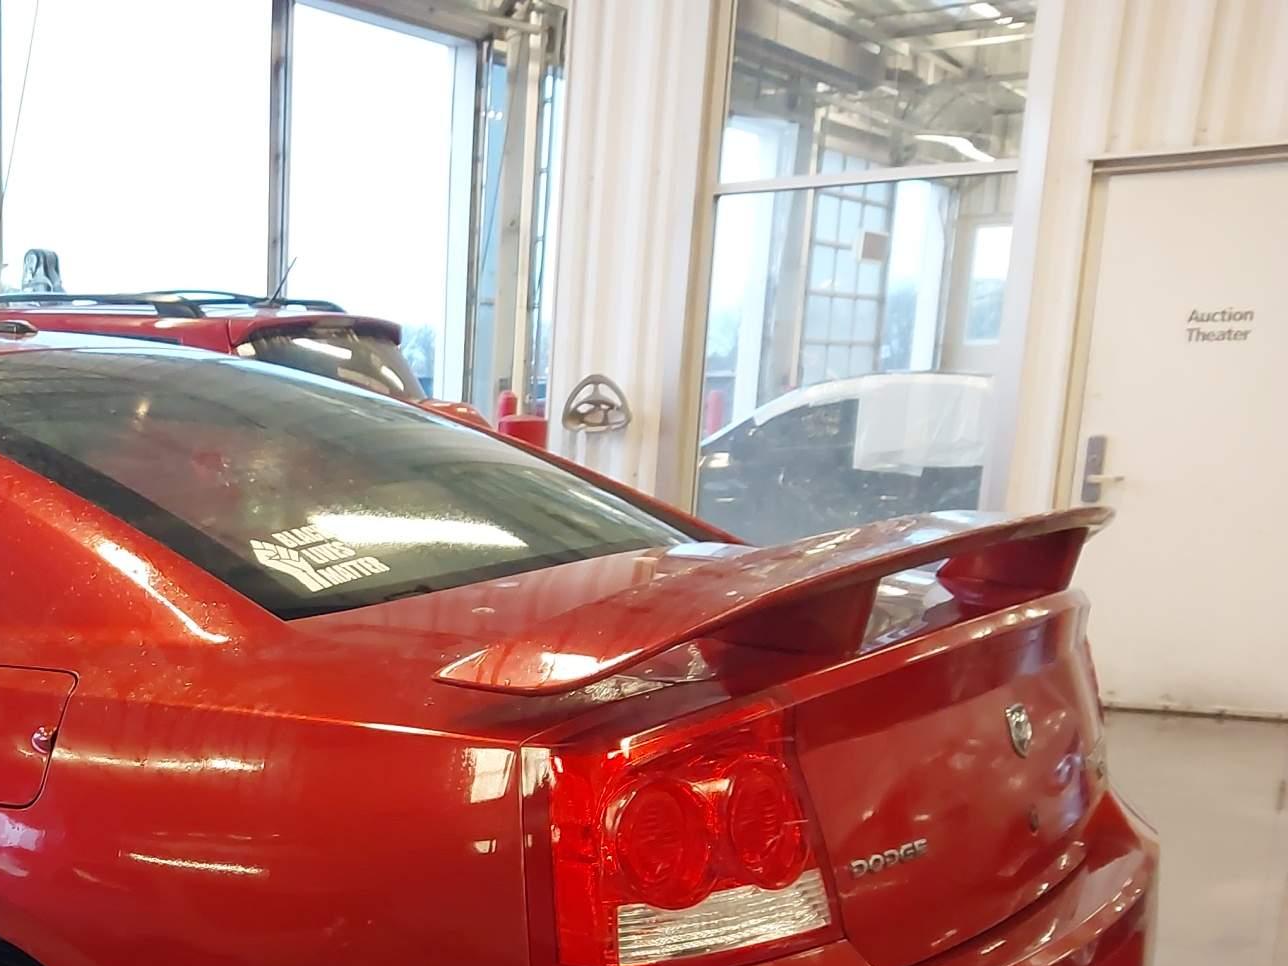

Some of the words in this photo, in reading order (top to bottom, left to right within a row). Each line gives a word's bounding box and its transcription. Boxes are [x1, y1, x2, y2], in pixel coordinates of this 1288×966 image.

[1187, 306, 1255, 323] Auction
[1186, 326, 1253, 342] Theater
[301, 541, 356, 564] LIVES
[316, 556, 390, 585] MATTER
[850, 837, 928, 878] DODGE
